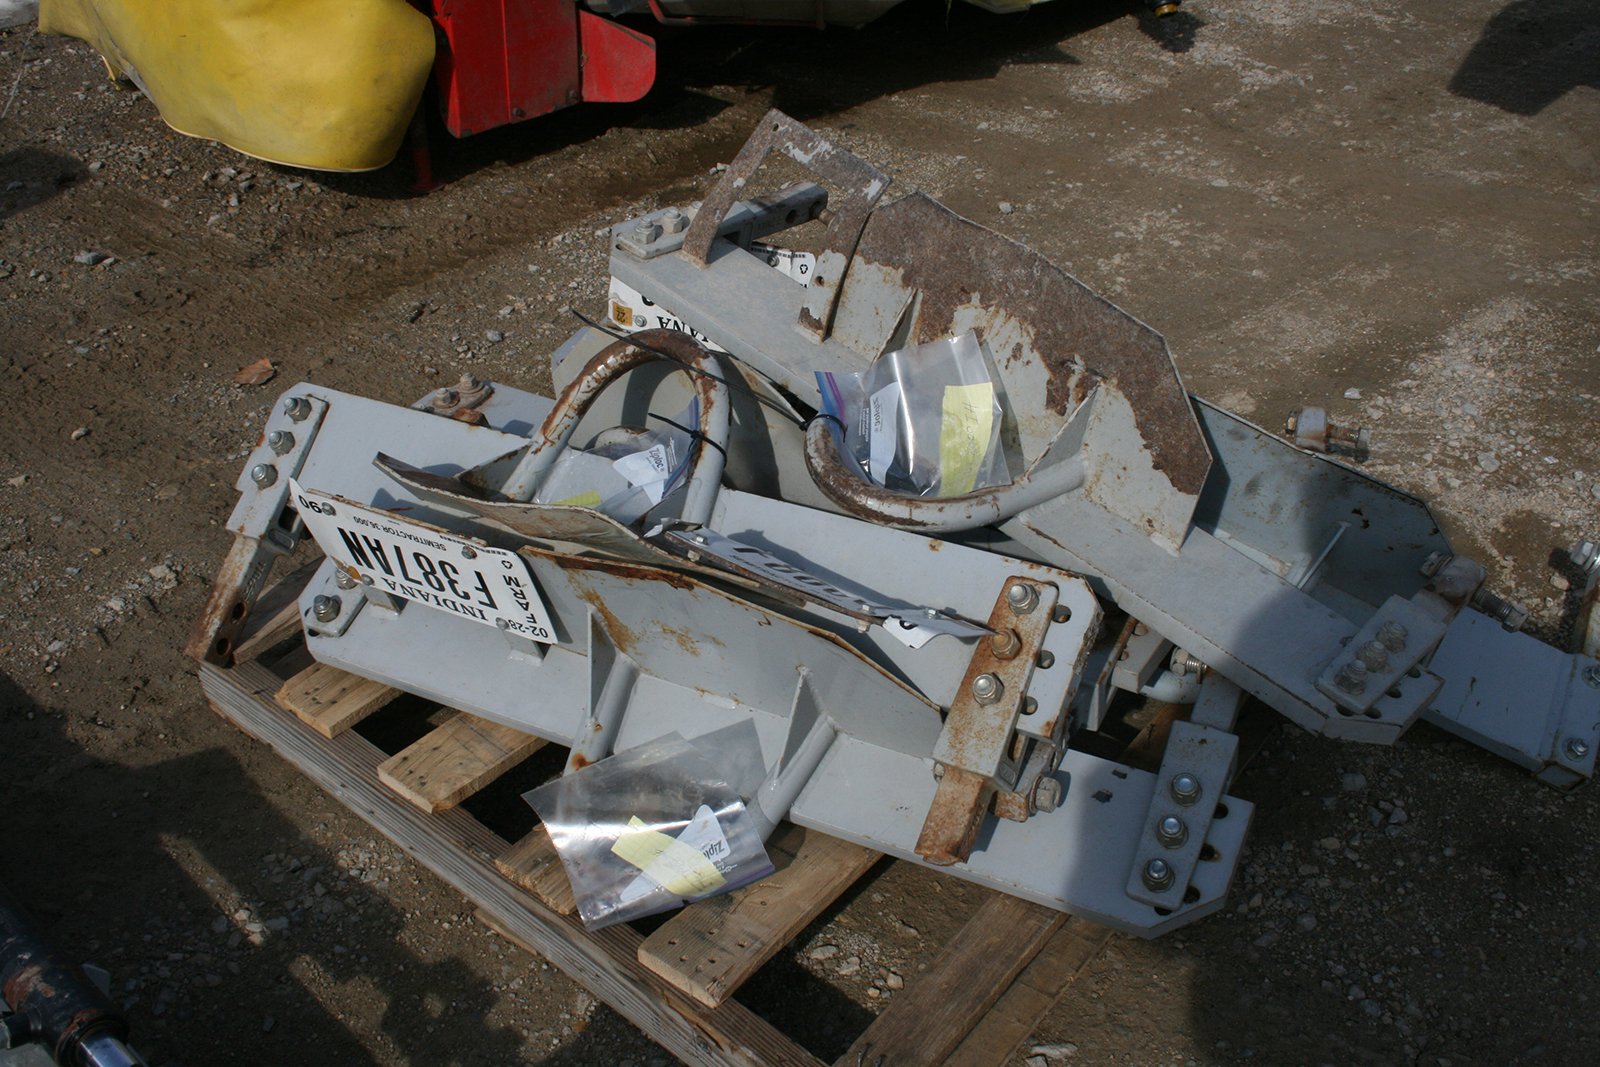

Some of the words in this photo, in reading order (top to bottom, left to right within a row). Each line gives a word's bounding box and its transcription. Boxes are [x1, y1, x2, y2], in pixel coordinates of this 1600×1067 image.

[298, 495, 323, 513] 90
[381, 525, 447, 552] SEMITRACTOR
[337, 527, 499, 610] F387AN
[381, 576, 490, 621] INDIANA
[502, 574, 537, 625] FARM
